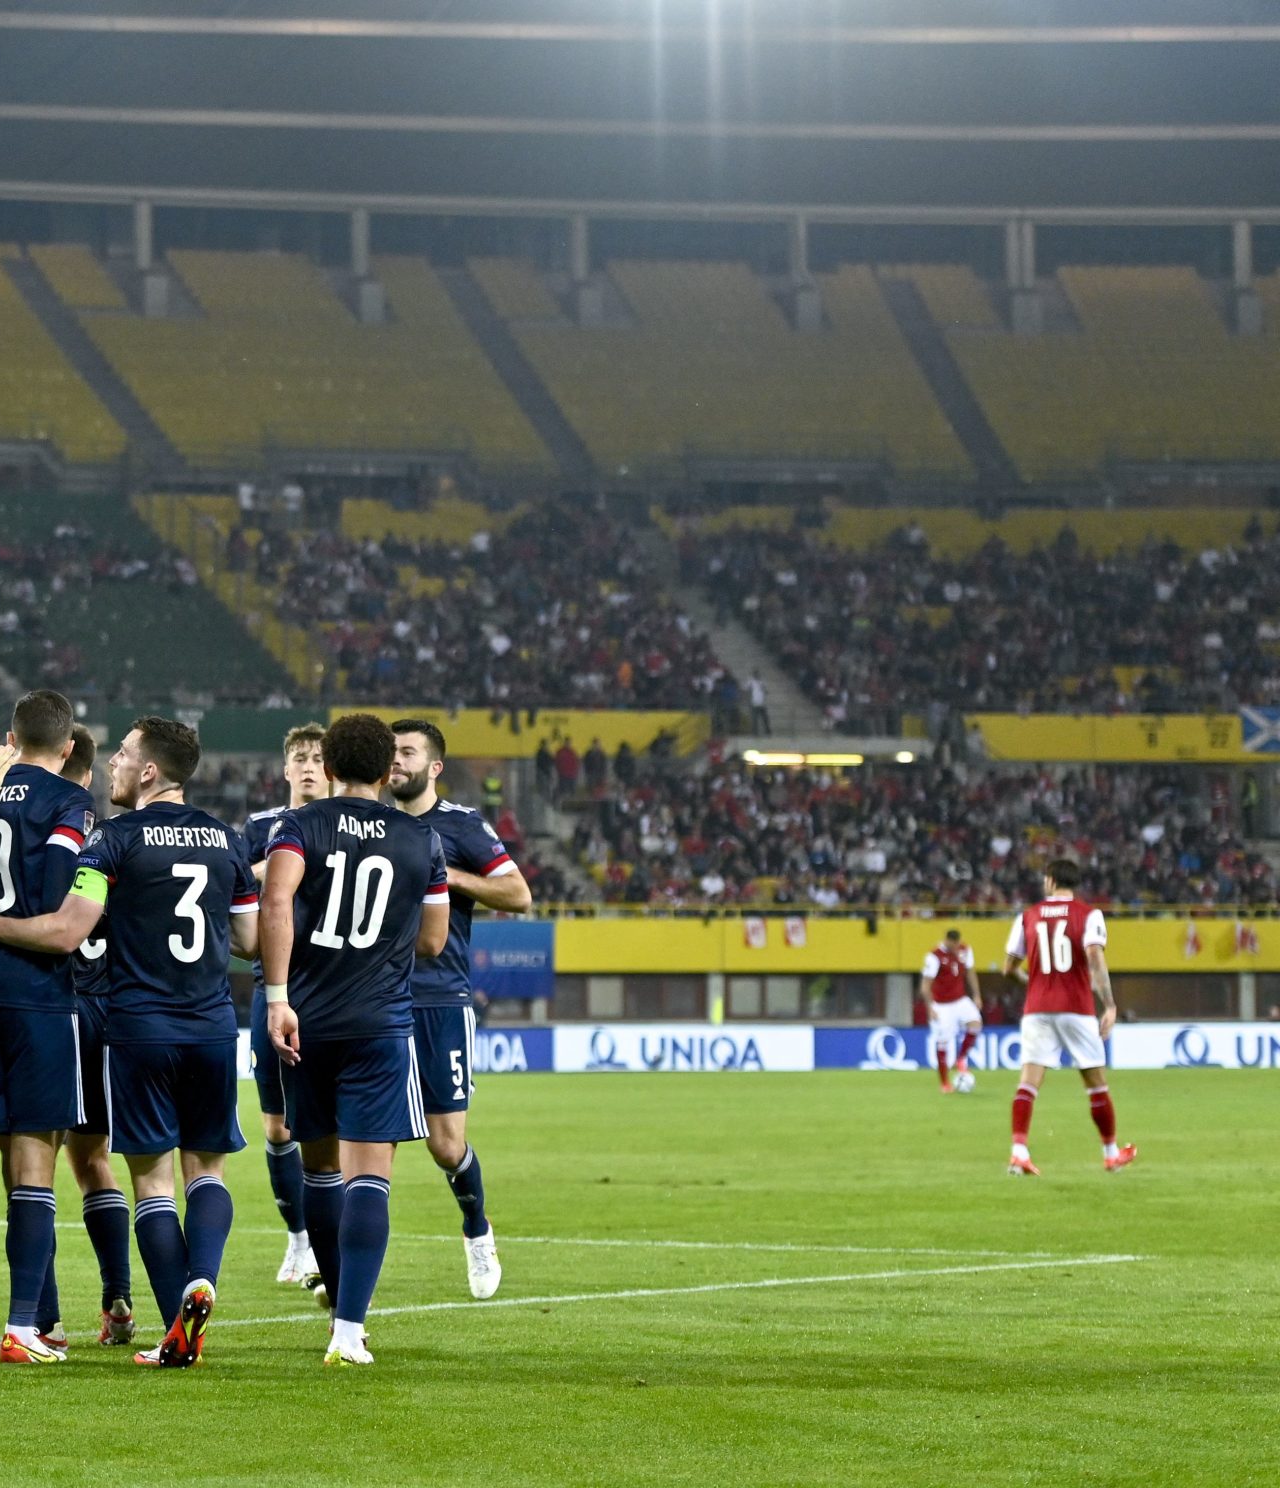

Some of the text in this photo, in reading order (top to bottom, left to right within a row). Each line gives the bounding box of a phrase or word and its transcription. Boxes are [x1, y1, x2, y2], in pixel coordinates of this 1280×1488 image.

[143, 826, 229, 849] ROBERTSON
[337, 813, 386, 840] ADAMS
[73, 870, 87, 890] C
[169, 863, 208, 963] 3
[310, 850, 394, 950] 10
[1035, 919, 1073, 975] 16
[449, 1050, 464, 1086] 5
[640, 1036, 764, 1071] UNIQA
